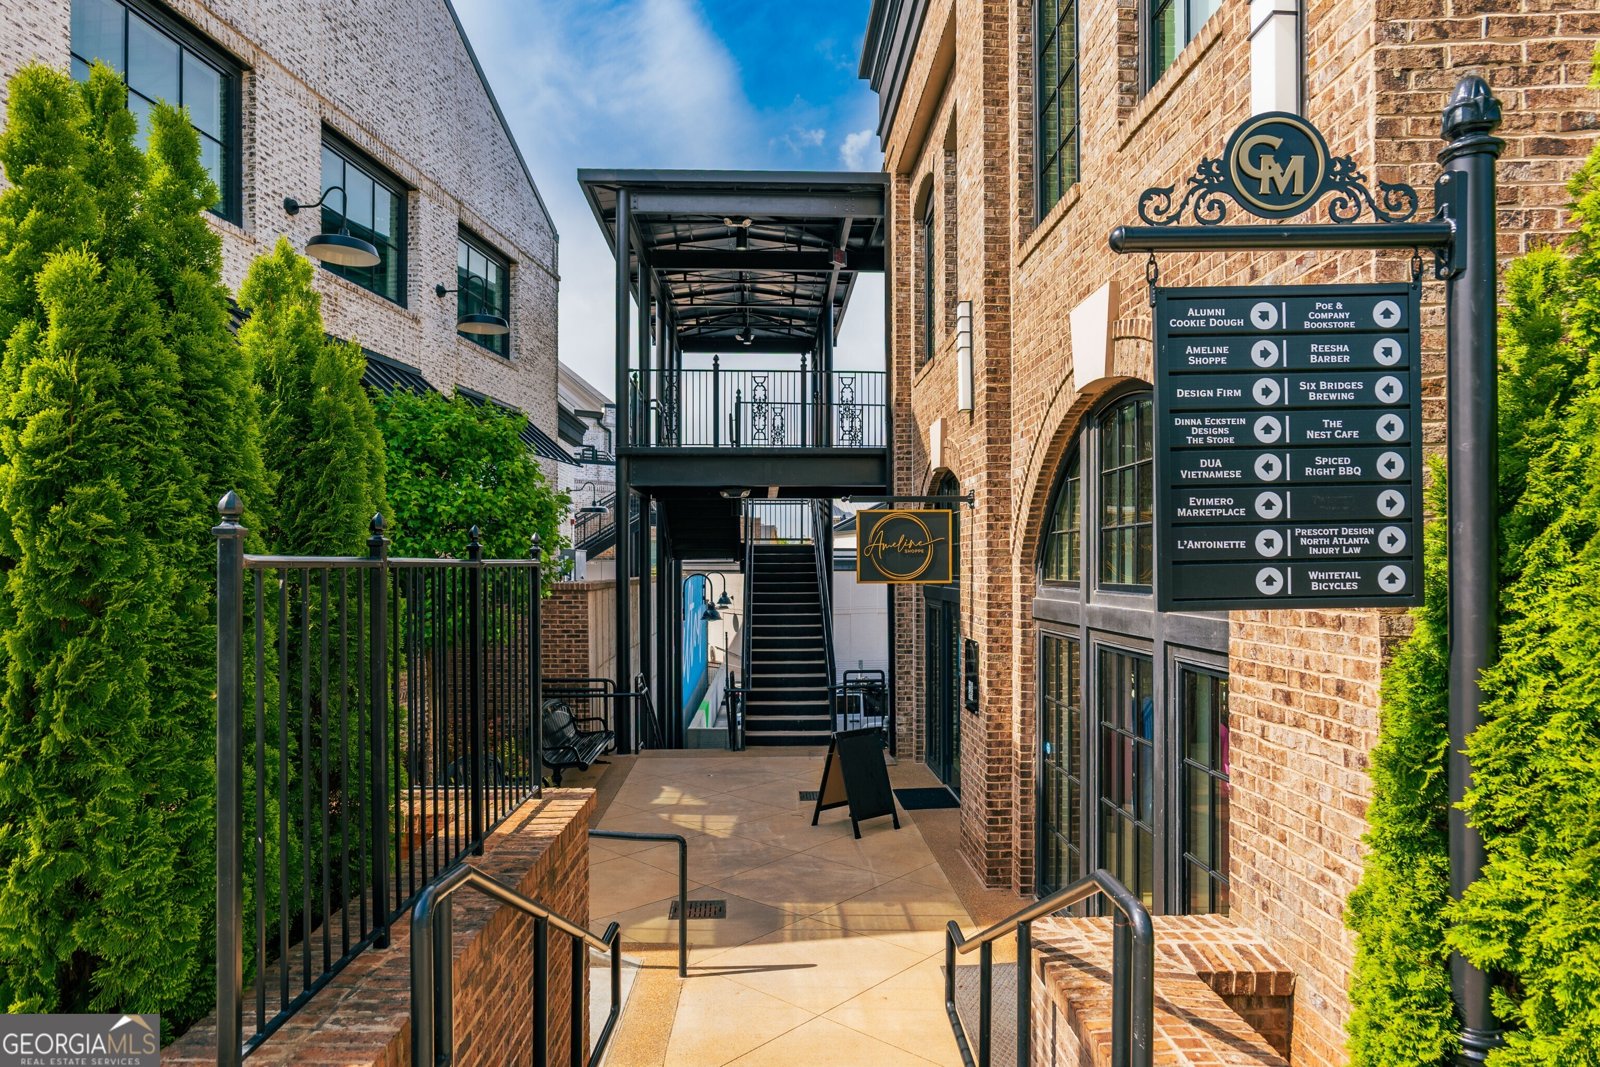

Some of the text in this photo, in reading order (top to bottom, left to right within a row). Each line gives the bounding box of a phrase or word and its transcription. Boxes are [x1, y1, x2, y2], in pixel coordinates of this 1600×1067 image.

[1316, 302, 1333, 310] POE
[1188, 308, 1225, 316] ALUMNI
[1308, 311, 1350, 319] COMPANY
[1170, 318, 1244, 327] COOKIE DOUGH
[1304, 321, 1355, 329] BOOKSTORE
[1186, 345, 1229, 354] AMELINE
[1311, 344, 1349, 353] REESHA
[1188, 356, 1227, 365] SHOPPE
[1310, 354, 1350, 363] BARBER
[1299, 381, 1363, 390] SIX BRIDGES
[1176, 388, 1241, 398] DESIGN FIRM
[1309, 392, 1354, 401] BREWING
[1174, 417, 1246, 426] DINNA ECKSTEIN
[1322, 419, 1342, 428] THE
[1191, 427, 1229, 435] DESIGNS
[1306, 429, 1359, 439] NEST CAFE
[1186, 436, 1235, 444] THE STORE
[1200, 459, 1222, 468] DUA
[1315, 456, 1350, 465] SPICED
[1181, 469, 1242, 478] VIETNAMESE
[1305, 466, 1361, 476] RIGHT BBQ
[1189, 497, 1234, 506] EVIMERO
[1177, 507, 1246, 517] MARKETPLACE
[1295, 527, 1374, 536] PRESCOTT DESIGN
[864, 530, 945, 559] Ameline
[1300, 537, 1370, 545] NORTH ATLANTA
[1309, 546, 1361, 555] INJURY LAW
[1308, 571, 1361, 580] WHITETAIL
[1311, 582, 1358, 590] BICYCLES
